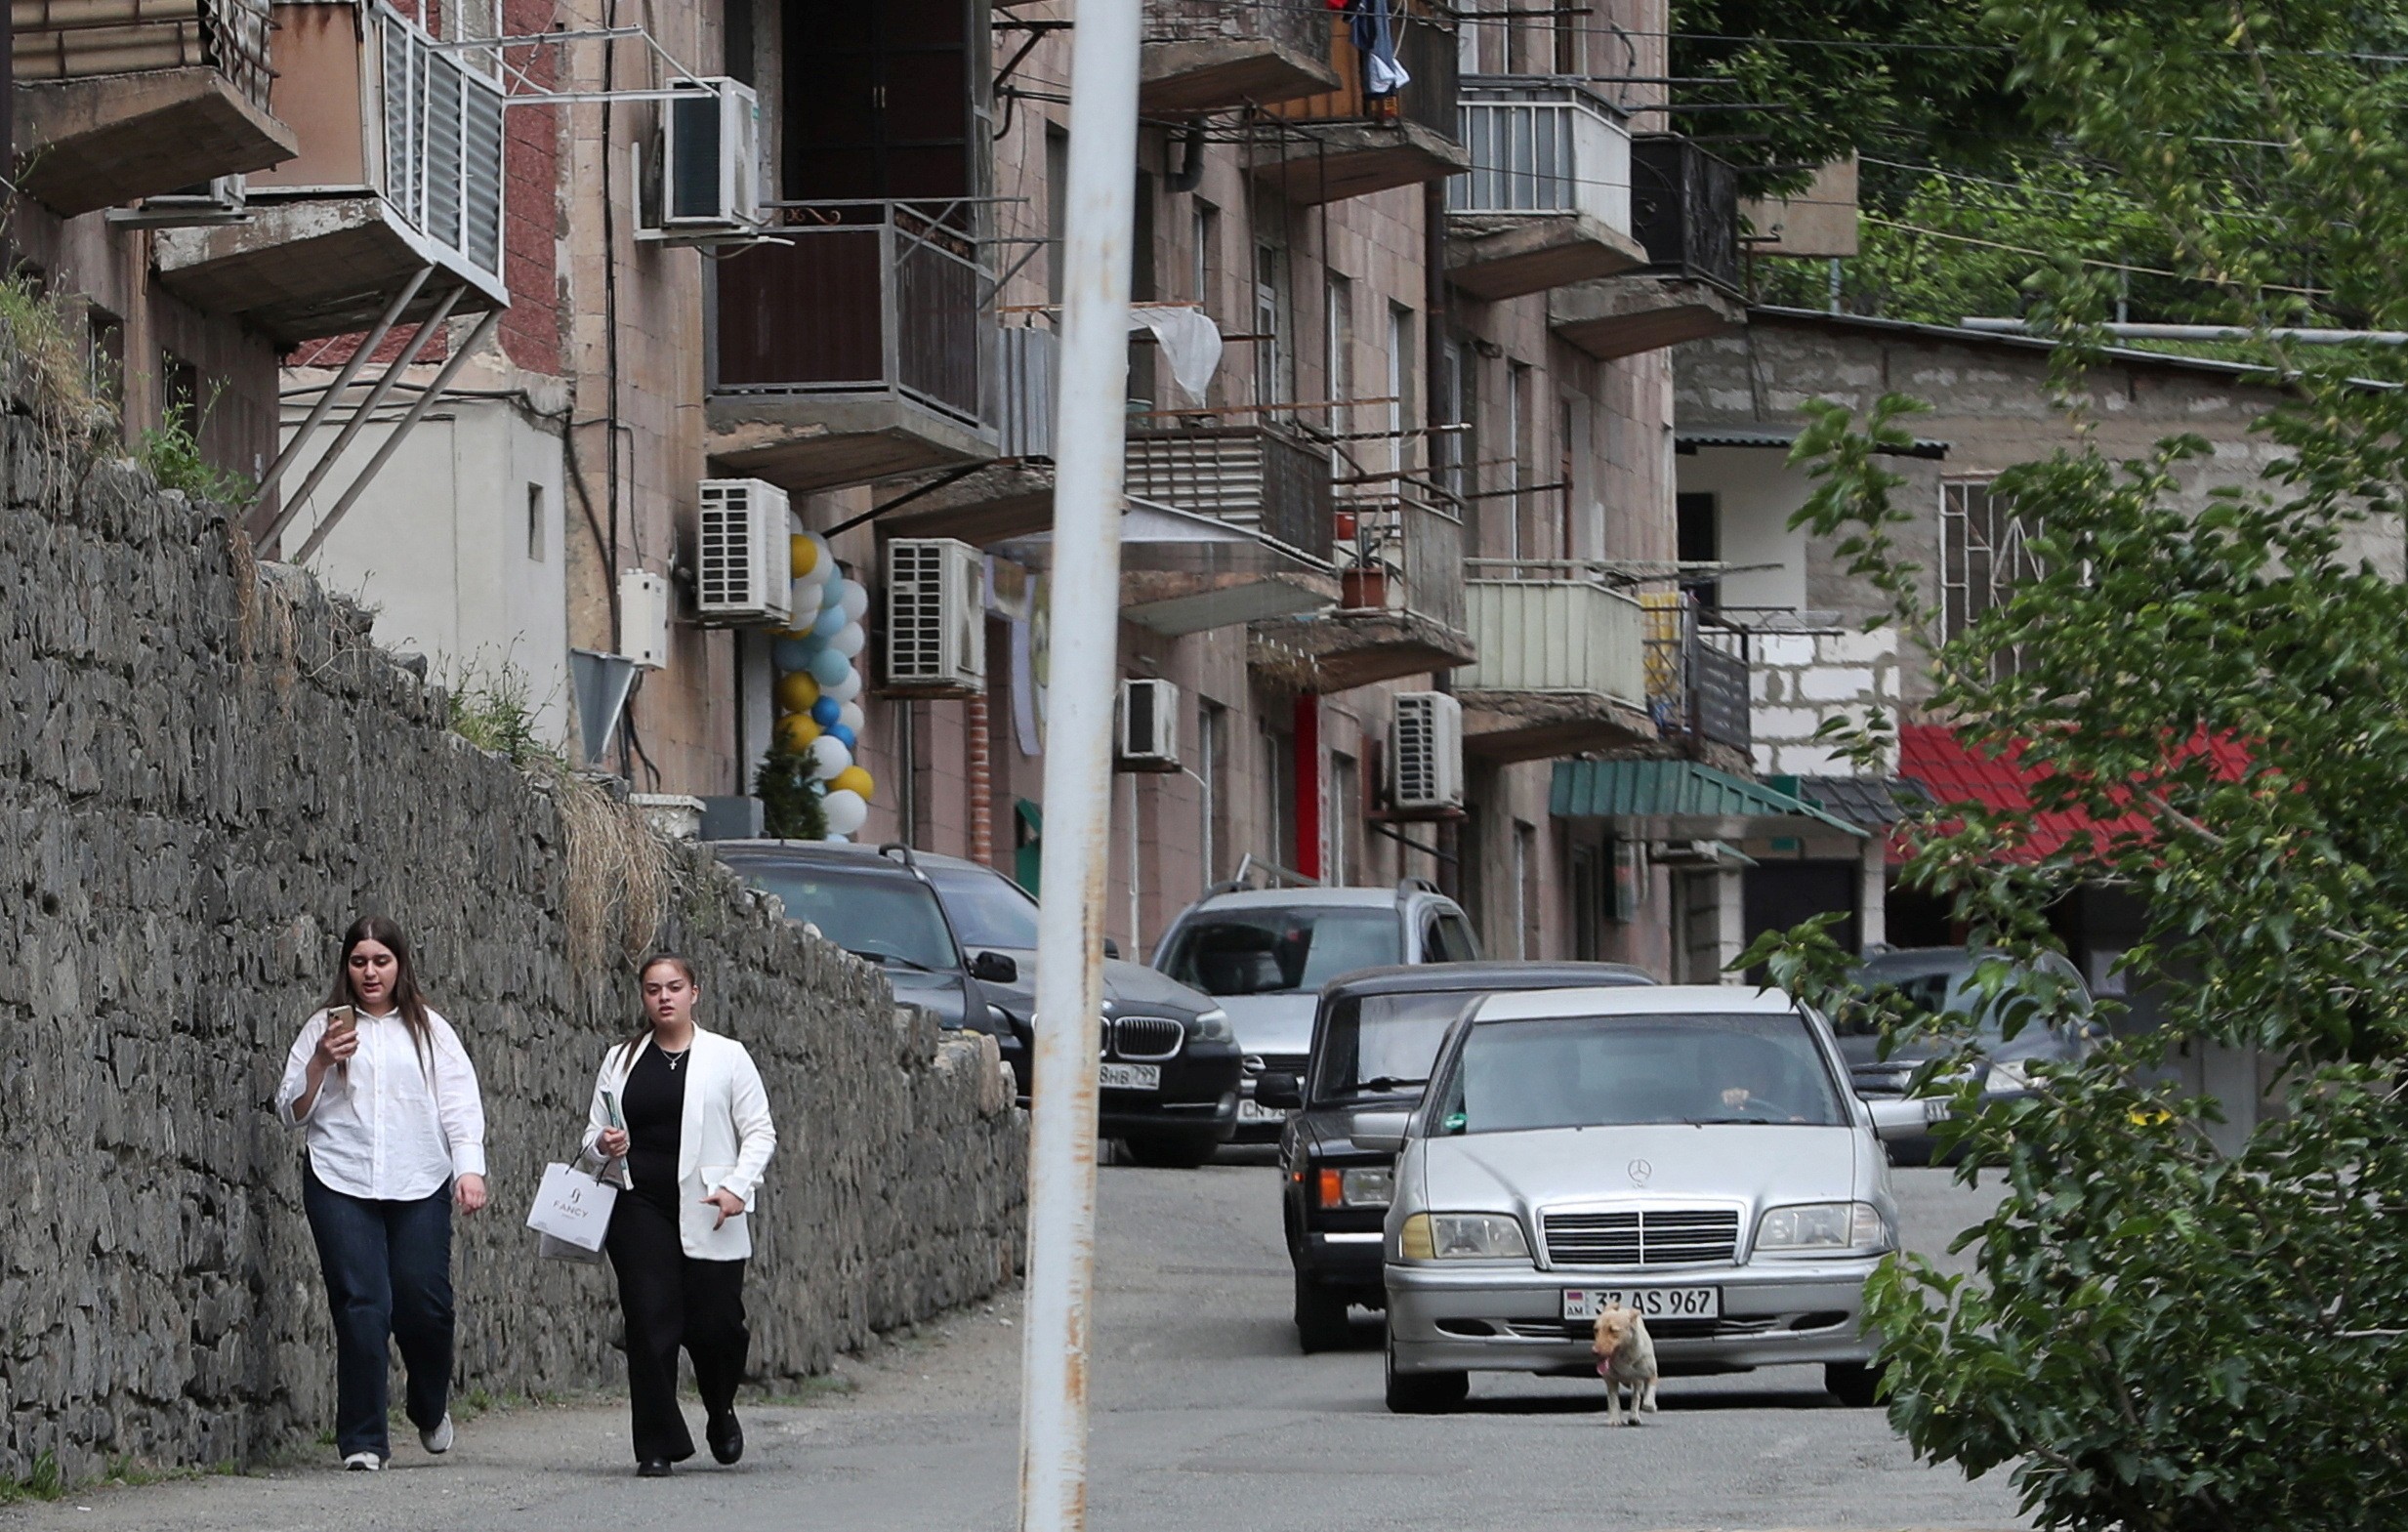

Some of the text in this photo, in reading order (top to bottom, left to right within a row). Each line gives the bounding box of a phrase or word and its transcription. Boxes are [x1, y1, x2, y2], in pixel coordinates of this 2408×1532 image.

[553, 1200, 589, 1219] FANCY
[1566, 1305, 1584, 1316] AM
[1632, 1290, 1662, 1315] AS
[1670, 1290, 1711, 1315] 967
